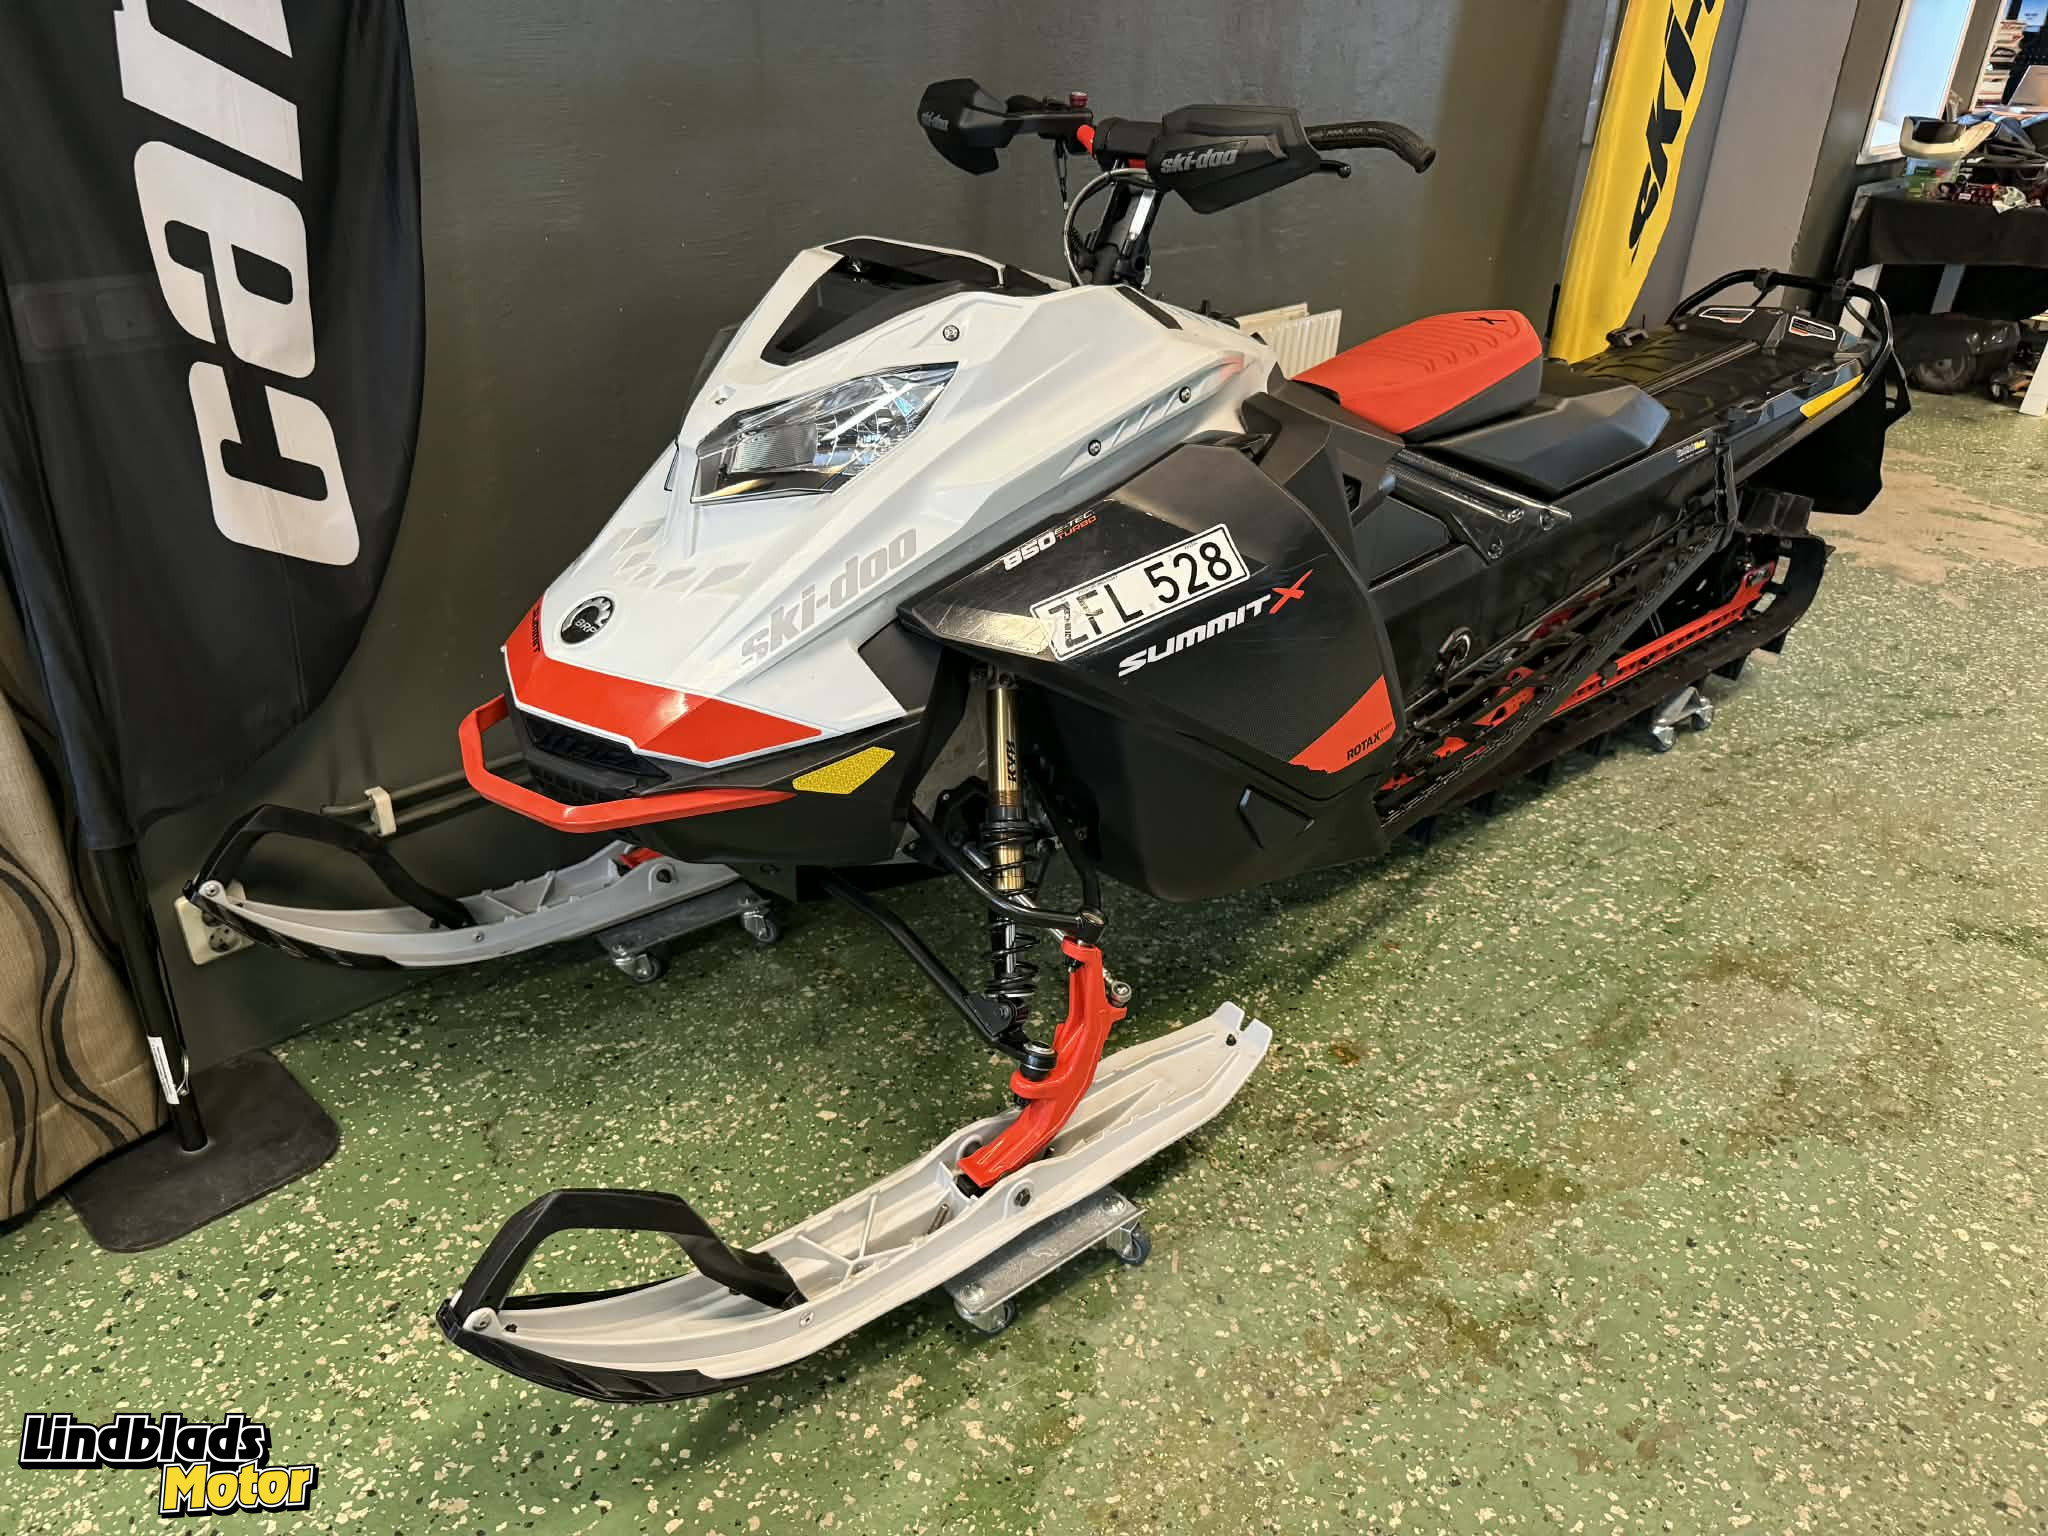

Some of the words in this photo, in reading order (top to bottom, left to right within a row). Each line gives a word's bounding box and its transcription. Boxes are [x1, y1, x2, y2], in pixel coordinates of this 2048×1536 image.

[1160, 148, 1239, 174] ski-doo
[1057, 514, 1097, 540] TURBO
[1003, 531, 1056, 570] 850
[741, 528, 917, 666] ski-doo
[1048, 583, 1145, 648] ZFL
[1143, 541, 1233, 604] 528
[575, 618, 598, 633] BRP
[1118, 593, 1272, 679] SUMMIT
[1346, 729, 1381, 761] ROTAX
